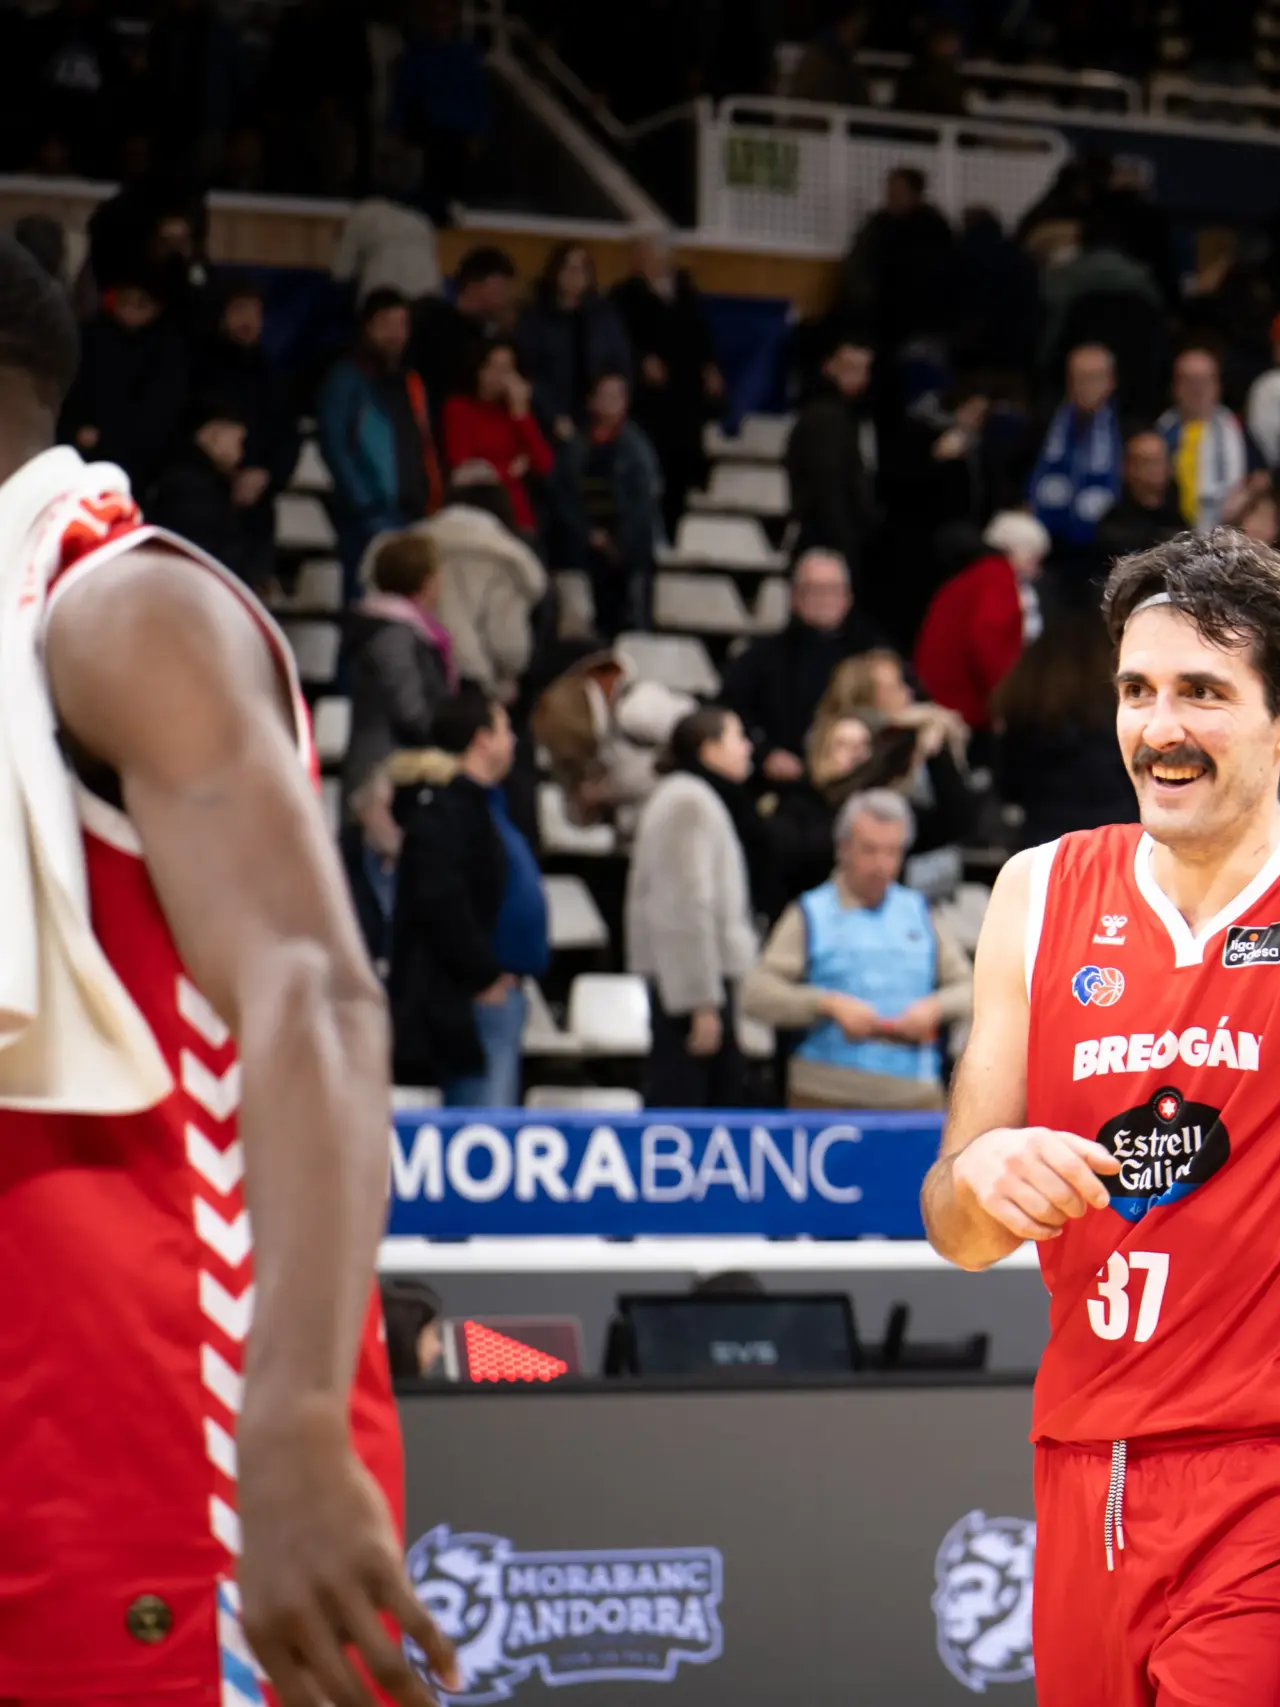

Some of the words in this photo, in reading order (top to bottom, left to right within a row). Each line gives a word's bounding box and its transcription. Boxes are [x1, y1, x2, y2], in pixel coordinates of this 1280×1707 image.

[1229, 947, 1279, 962] endesa
[1231, 939, 1255, 952] liga
[1073, 1016, 1263, 1081] BREOGÁN
[1113, 1124, 1202, 1158] Estrell
[388, 1123, 863, 1203] MORABANC
[1119, 1157, 1194, 1190] Gali
[1086, 1250, 1170, 1343] 37
[507, 1562, 709, 1597] MORABANC
[506, 1596, 708, 1649] ANDORRA
